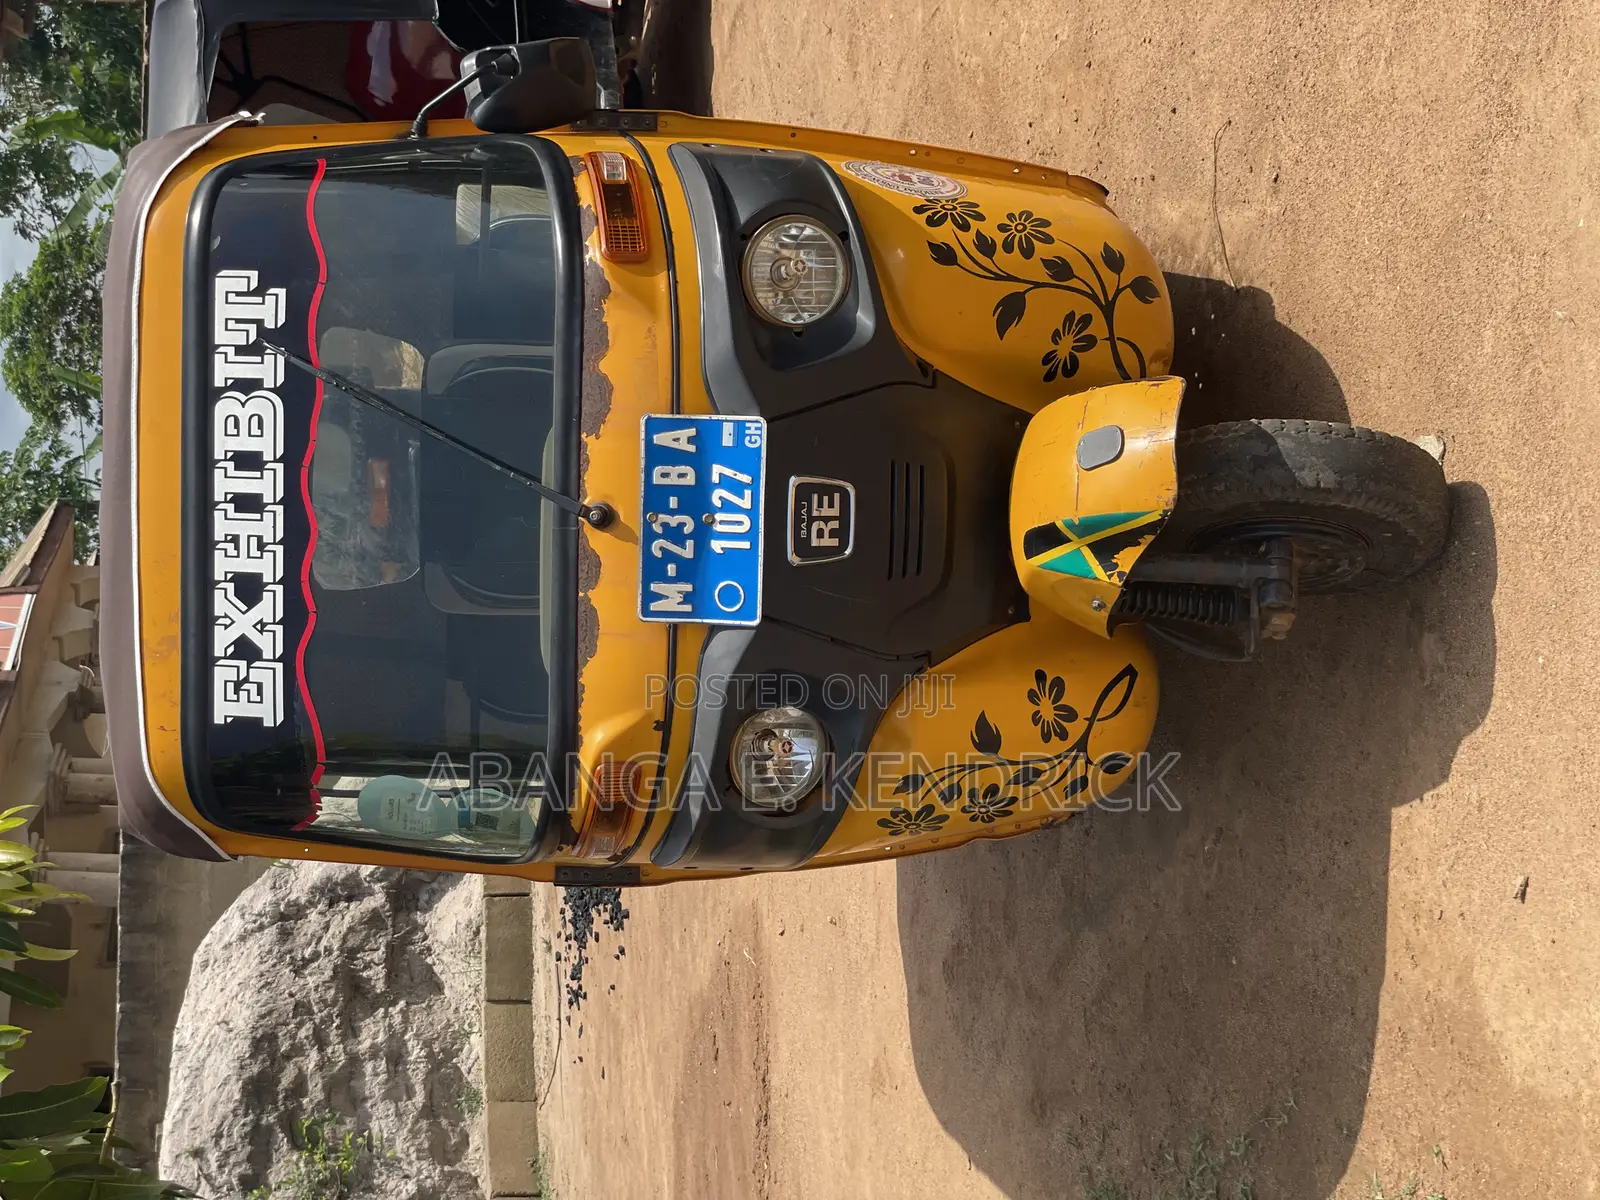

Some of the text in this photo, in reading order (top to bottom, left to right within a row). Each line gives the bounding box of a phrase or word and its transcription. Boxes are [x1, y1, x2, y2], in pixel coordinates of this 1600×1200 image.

[744, 422, 762, 449] GH
[212, 269, 287, 727] EXHIBIT
[710, 463, 753, 554] 1027
[800, 501, 808, 538] BAJAJ
[810, 492, 840, 547] RE
